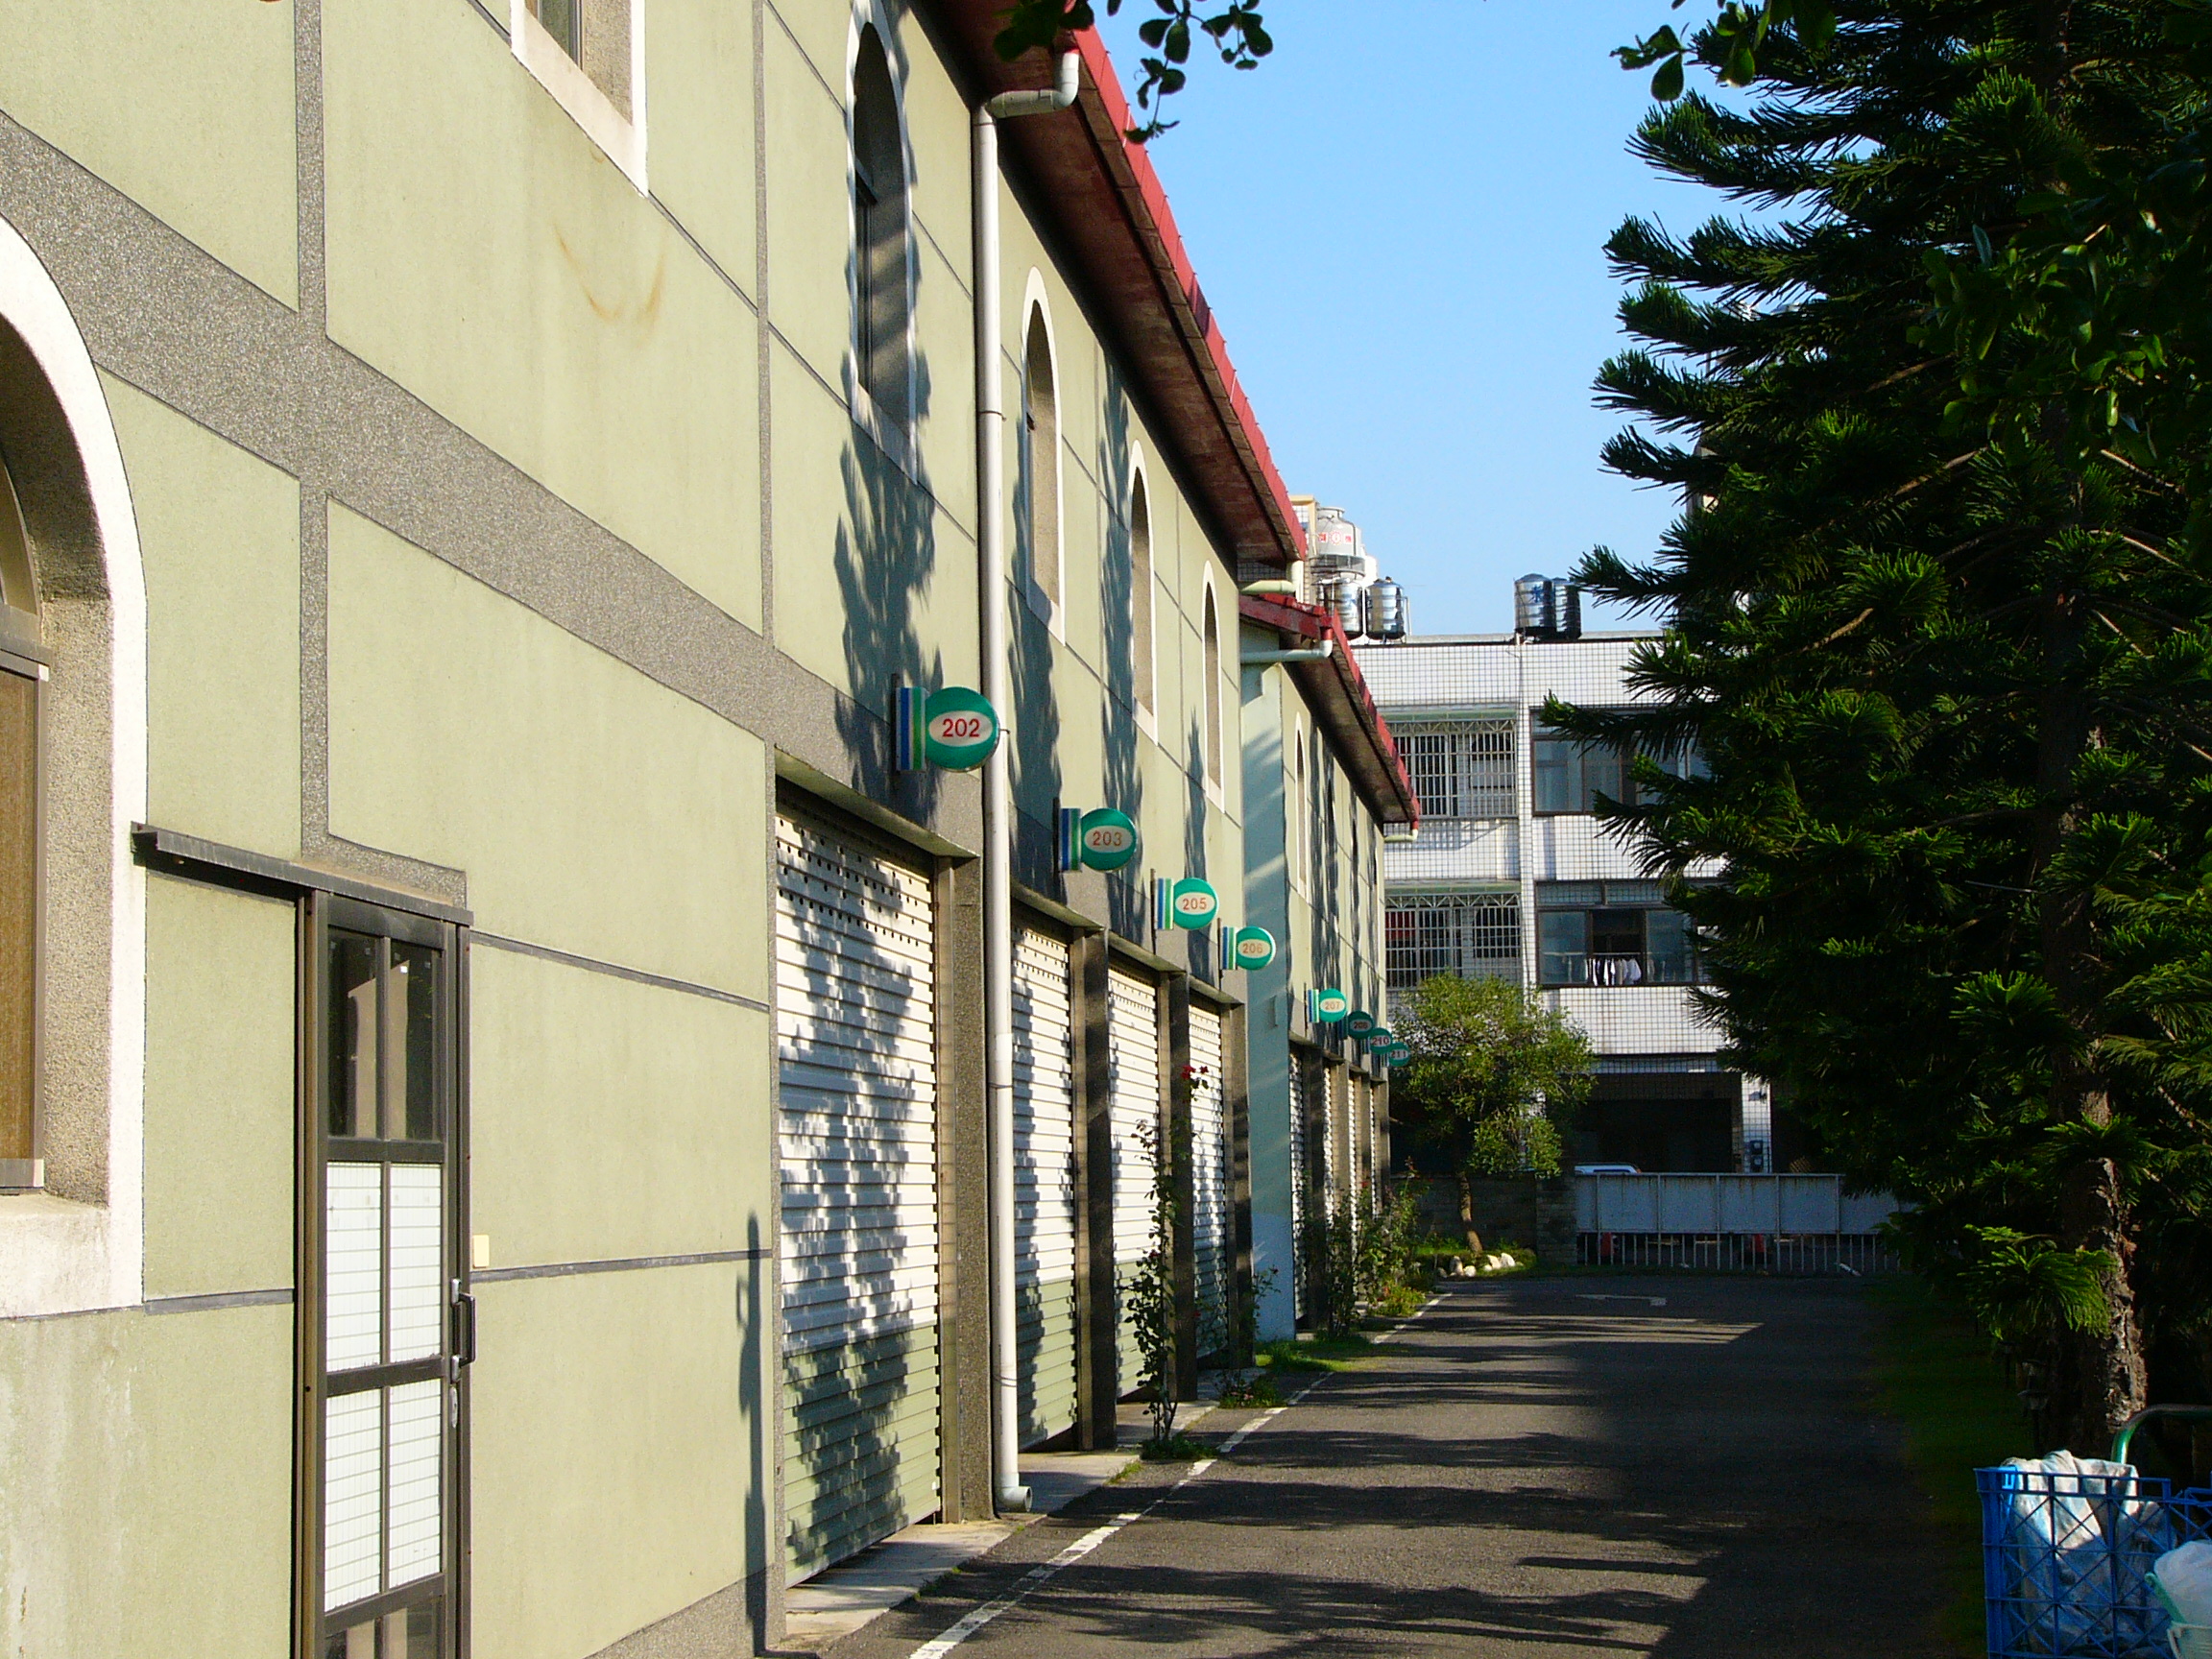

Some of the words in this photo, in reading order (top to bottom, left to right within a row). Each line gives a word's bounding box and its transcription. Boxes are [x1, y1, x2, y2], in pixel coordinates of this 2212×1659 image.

[942, 718, 980, 737] 202
[1093, 830, 1122, 846] 203
[1182, 898, 1207, 910] 205
[1242, 942, 1262, 953] 206
[1324, 1000, 1340, 1010] 207
[1372, 1036, 1389, 1046] 210
